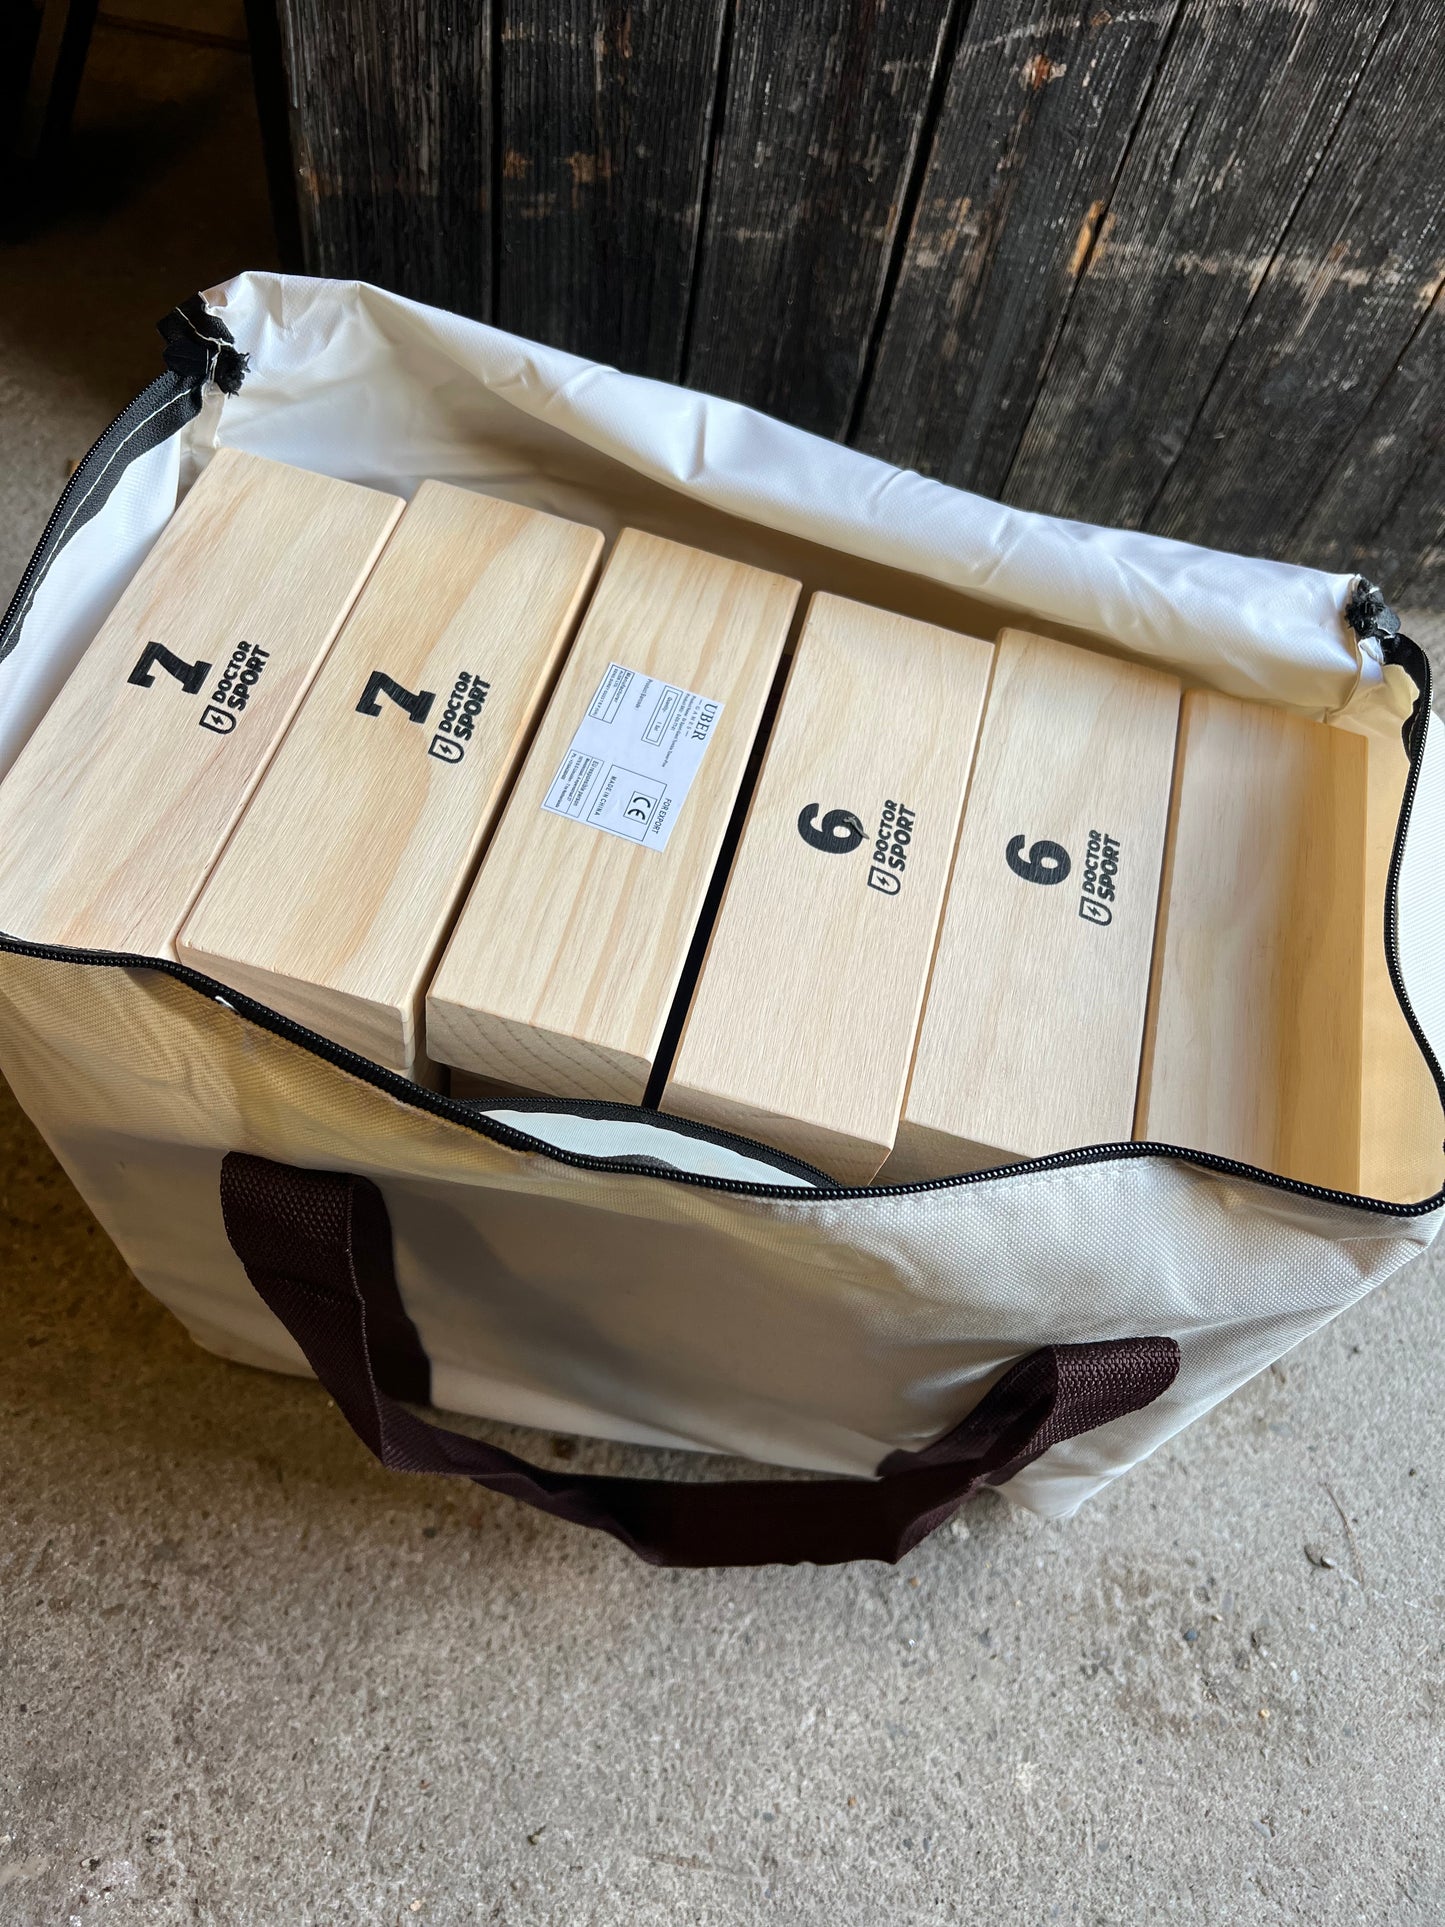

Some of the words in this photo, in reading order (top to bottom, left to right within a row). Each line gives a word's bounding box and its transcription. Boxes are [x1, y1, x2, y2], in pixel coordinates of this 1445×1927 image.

[127, 641, 212, 695] 7
[211, 640, 252, 704] DOCTOR
[228, 645, 270, 712] SPORT
[613, 672, 631, 703] Manufacturer
[355, 670, 437, 724] 7
[438, 671, 473, 733] DOCTOR
[453, 675, 491, 741] SPORT
[690, 702, 718, 742] UBER
[571, 791, 583, 806] person
[579, 766, 595, 791] responsible
[605, 775, 616, 791] MADE
[660, 797, 671, 810] FOR
[594, 798, 606, 816] CHINA
[627, 794, 652, 820] CE
[651, 810, 666, 834] EXPORT
[798, 802, 865, 854] 6
[873, 799, 897, 864] DOCTOR
[888, 804, 916, 872] SPORT
[1006, 834, 1071, 885] 6
[1082, 829, 1102, 895] DOCTOR
[1097, 834, 1121, 903] SPORT
